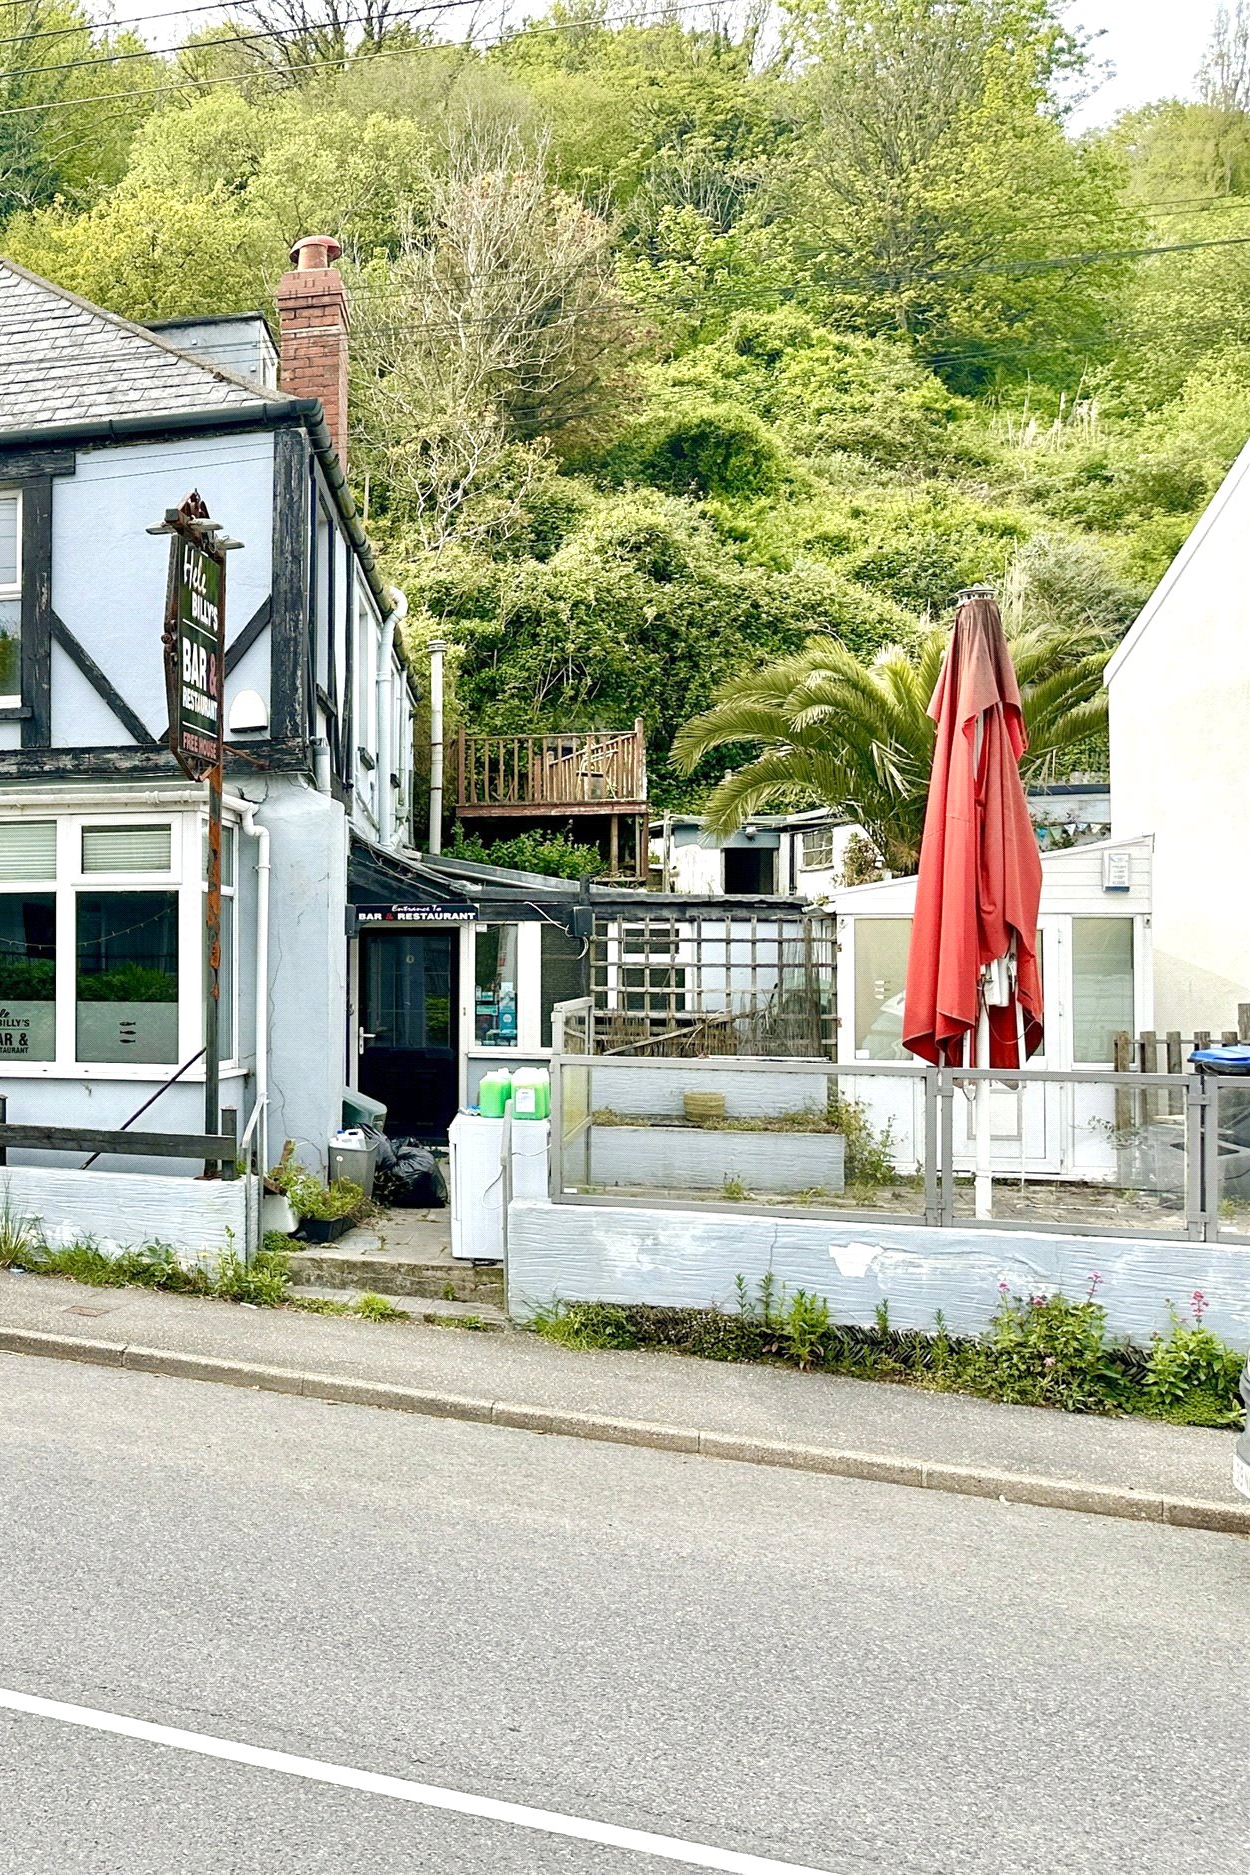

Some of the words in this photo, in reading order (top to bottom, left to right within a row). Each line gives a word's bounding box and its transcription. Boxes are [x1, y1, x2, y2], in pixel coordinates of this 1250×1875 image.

[183, 544, 207, 595] Hele
[192, 591, 218, 632] BILLY'S
[182, 636, 207, 691] BAR
[209, 653, 217, 697] &
[182, 685, 218, 721] RESTAURANT
[183, 731, 198, 753] FREE
[199, 736, 217, 759] HOUSE
[358, 912, 382, 920] BAR
[385, 912, 393, 921] &
[397, 912, 476, 920] RESTAURANT
[391, 904, 430, 912] Entrance
[432, 904, 442, 912] To
[19, 1032, 28, 1046] &
